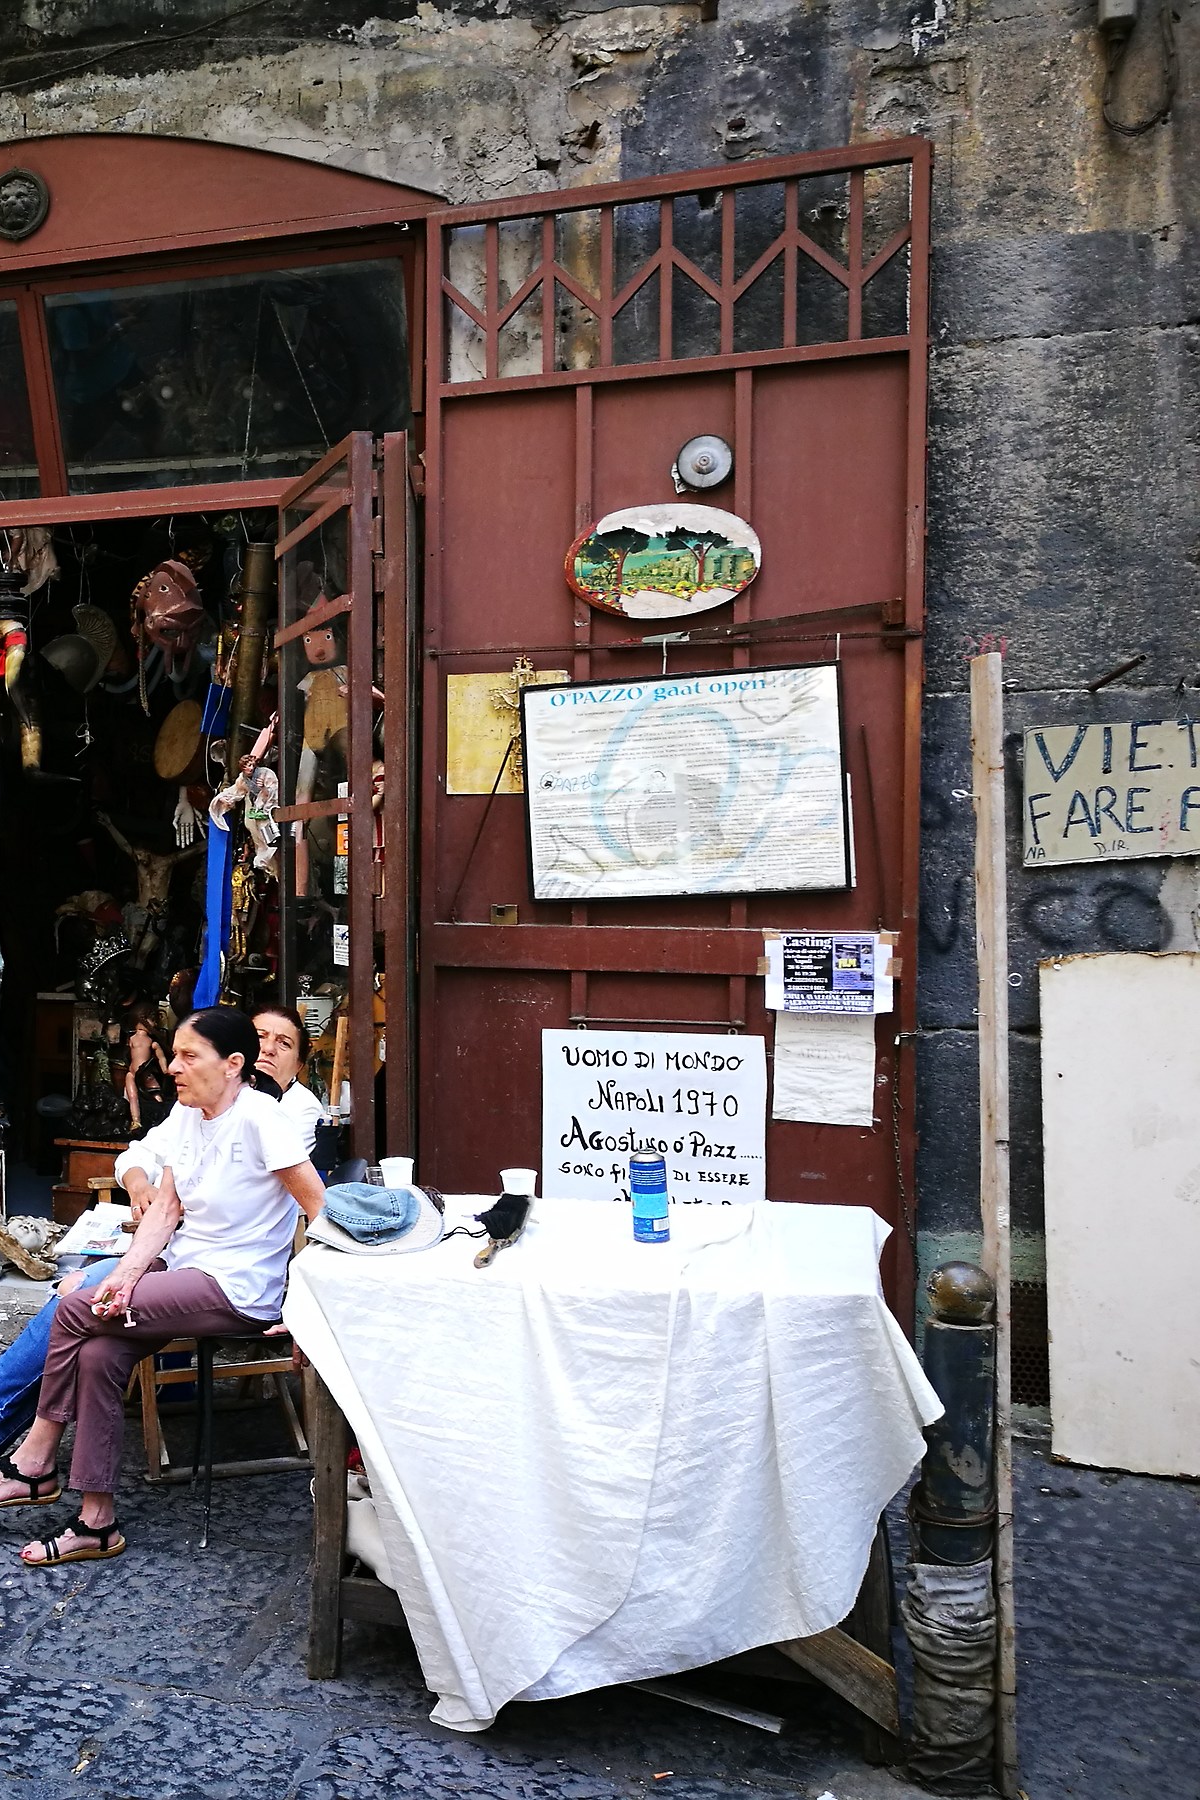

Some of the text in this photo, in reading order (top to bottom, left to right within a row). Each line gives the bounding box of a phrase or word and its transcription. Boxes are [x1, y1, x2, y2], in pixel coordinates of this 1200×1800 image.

[653, 681, 701, 702] gaat
[784, 935, 833, 950] Casting
[561, 1045, 745, 1073] UOMO DI MONDO
[672, 1088, 739, 1117] 1970
[558, 1161, 605, 1178] SONO
[672, 1169, 691, 1183] DI
[697, 1170, 751, 1186] ESSERE
